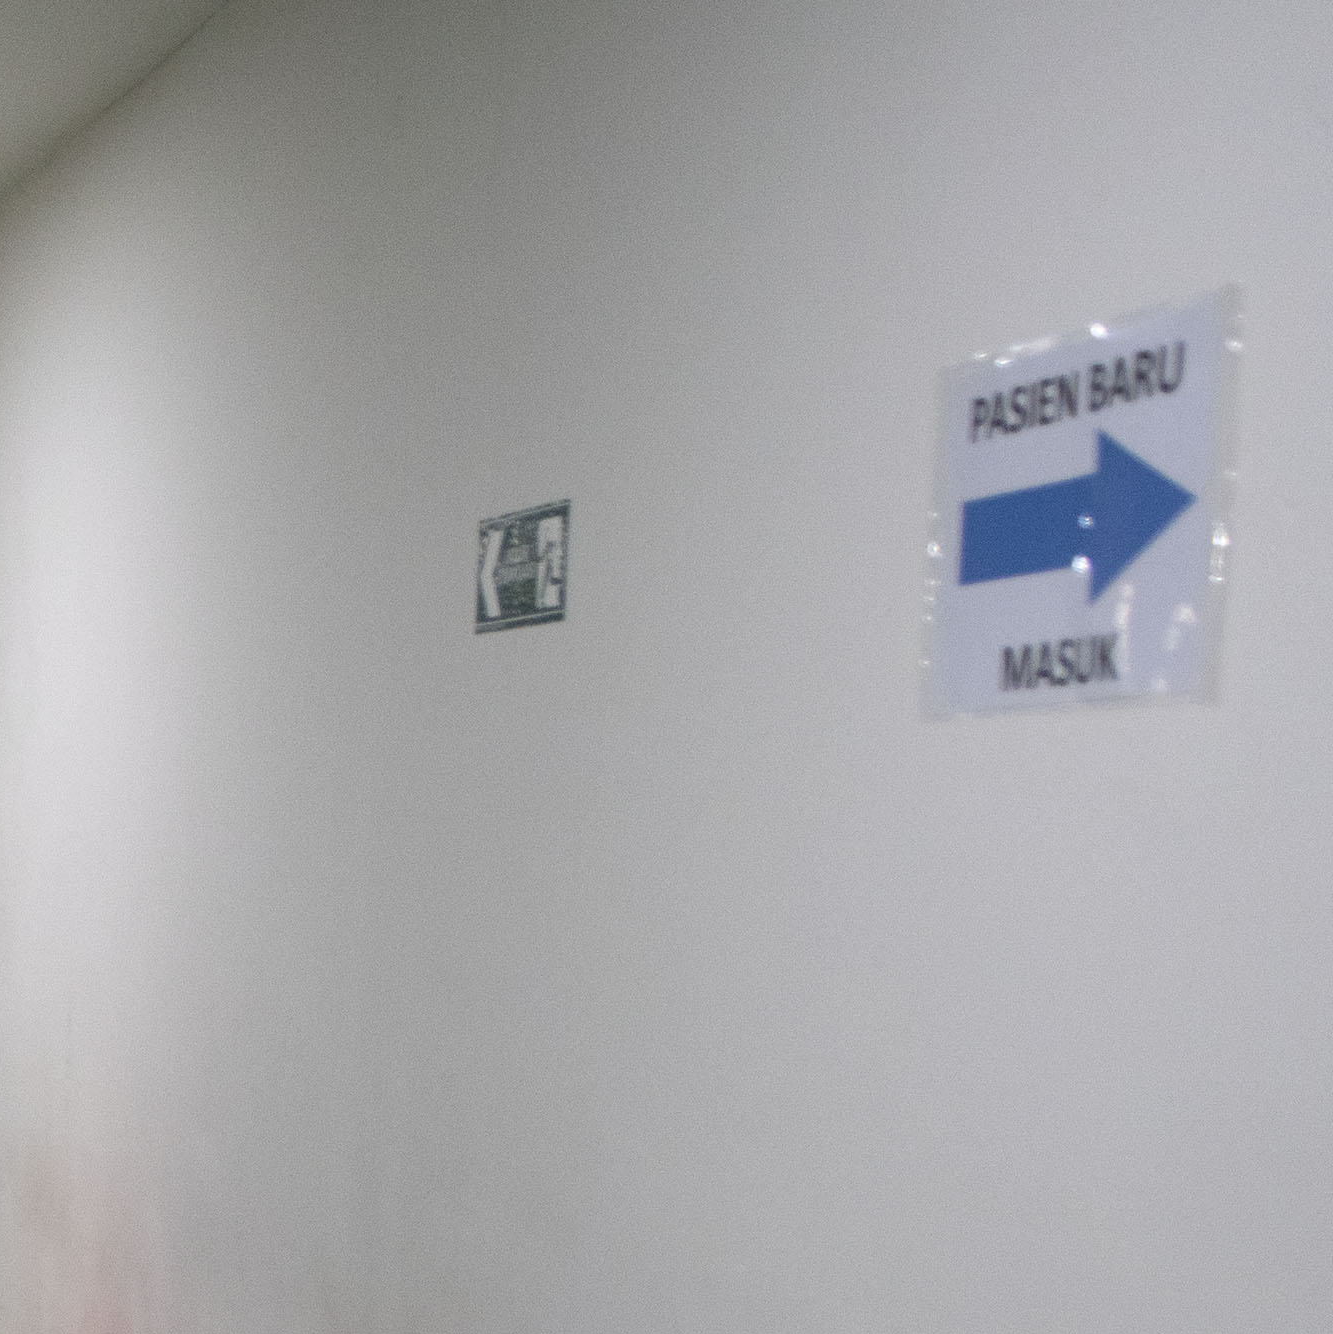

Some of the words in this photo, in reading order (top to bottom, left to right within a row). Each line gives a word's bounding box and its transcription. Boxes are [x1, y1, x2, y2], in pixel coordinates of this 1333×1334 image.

[968, 371, 1080, 443] PASIEN
[1088, 341, 1187, 412] BARU
[1000, 632, 1120, 692] MASUK
